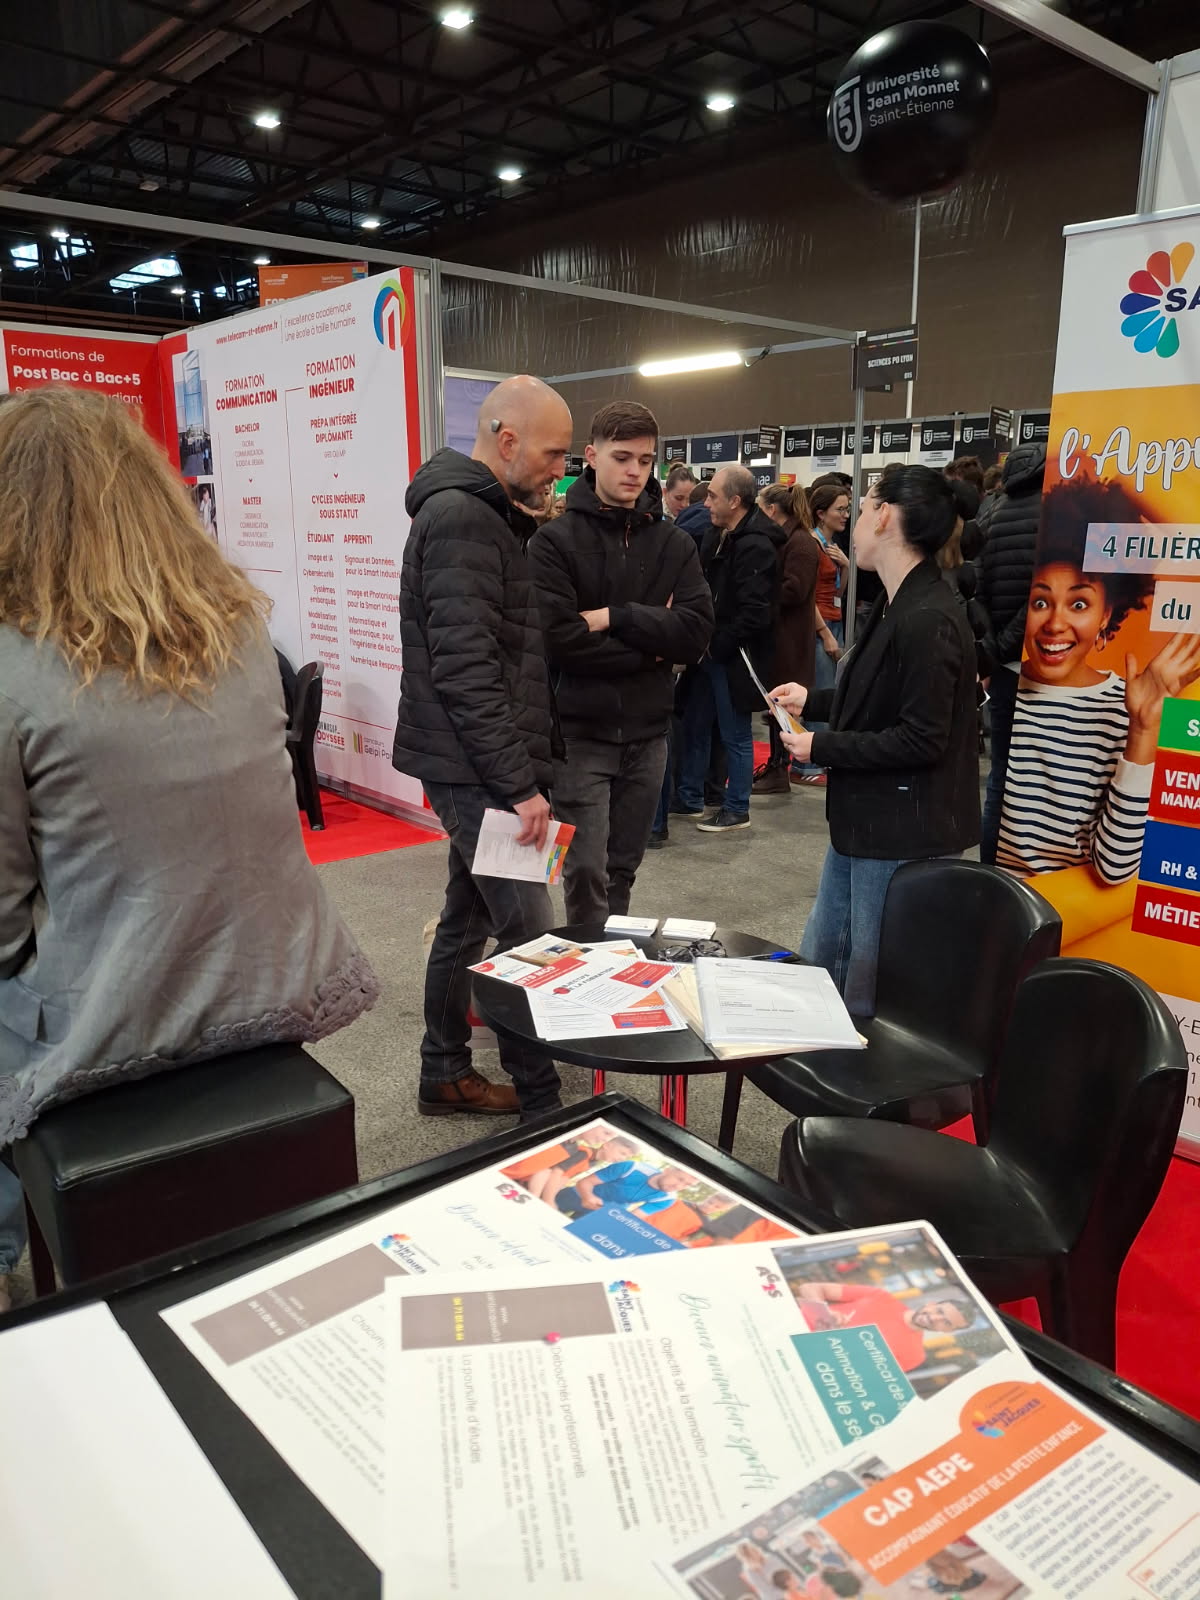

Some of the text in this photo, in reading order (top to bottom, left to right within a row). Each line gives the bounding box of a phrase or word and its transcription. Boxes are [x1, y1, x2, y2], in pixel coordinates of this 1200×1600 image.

[866, 64, 940, 95] Université
[867, 79, 960, 111] Jean Monnet
[869, 99, 955, 128] Saint-Étienne
[330, 316, 356, 333] humaine
[11, 344, 105, 362] Formations de
[867, 353, 914, 368] SCIENCES PO LYON
[13, 365, 141, 386] Post Bac à Bac+5
[306, 354, 356, 376] FORMATION
[225, 374, 265, 392] FORMATION
[309, 378, 355, 398] INGÉNIEUR
[216, 389, 278, 411] COMMUNICATION
[234, 422, 260, 434] BACHELOR
[310, 412, 358, 429] PRÉPA INTÉGRÉE
[315, 430, 353, 443] DIPLÔMANTE
[242, 496, 262, 505] MASTER
[311, 491, 366, 504] CYCLES INGÉNIEUR
[319, 509, 359, 519] SOUS STATUT
[307, 531, 335, 543] ÉTUDIANT
[343, 534, 373, 545] APPRENTI
[1102, 535, 1117, 558] 4
[345, 568, 357, 577] pour
[363, 568, 380, 577] Smart
[380, 569, 401, 579] Industri
[313, 585, 336, 595] Systèmes
[365, 602, 381, 611] Smart
[1161, 598, 1192, 621] du
[350, 655, 378, 668] Numérique
[1187, 719, 1200, 737] S
[381, 749, 393, 760] Pol
[1161, 860, 1197, 881] RH &
[607, 1208, 656, 1246] Certificat
[654, 1235, 672, 1251] de
[393, 1240, 417, 1257] SAINT
[591, 1232, 627, 1258] dans
[392, 1249, 428, 1275] JACQUES
[622, 1288, 635, 1312] SAINT
[614, 1296, 633, 1334] JACQUES
[462, 1353, 473, 1369] La
[858, 1330, 905, 1402] Certificat de
[463, 1367, 477, 1413] poursuite
[815, 1361, 844, 1399] dans
[834, 1400, 853, 1416] le
[827, 1336, 887, 1431] Animation & G
[660, 1336, 709, 1459] Objectifs de la formation
[985, 1406, 1014, 1427] SAINT
[1003, 1398, 1041, 1428] JACQUES
[559, 1401, 586, 1481] professionnels
[863, 1452, 975, 1527] CAP AEPE
[867, 1420, 1084, 1572] ACCOMPAGNANT ÉDUCATIF DE LA PETITE ENFANCE
